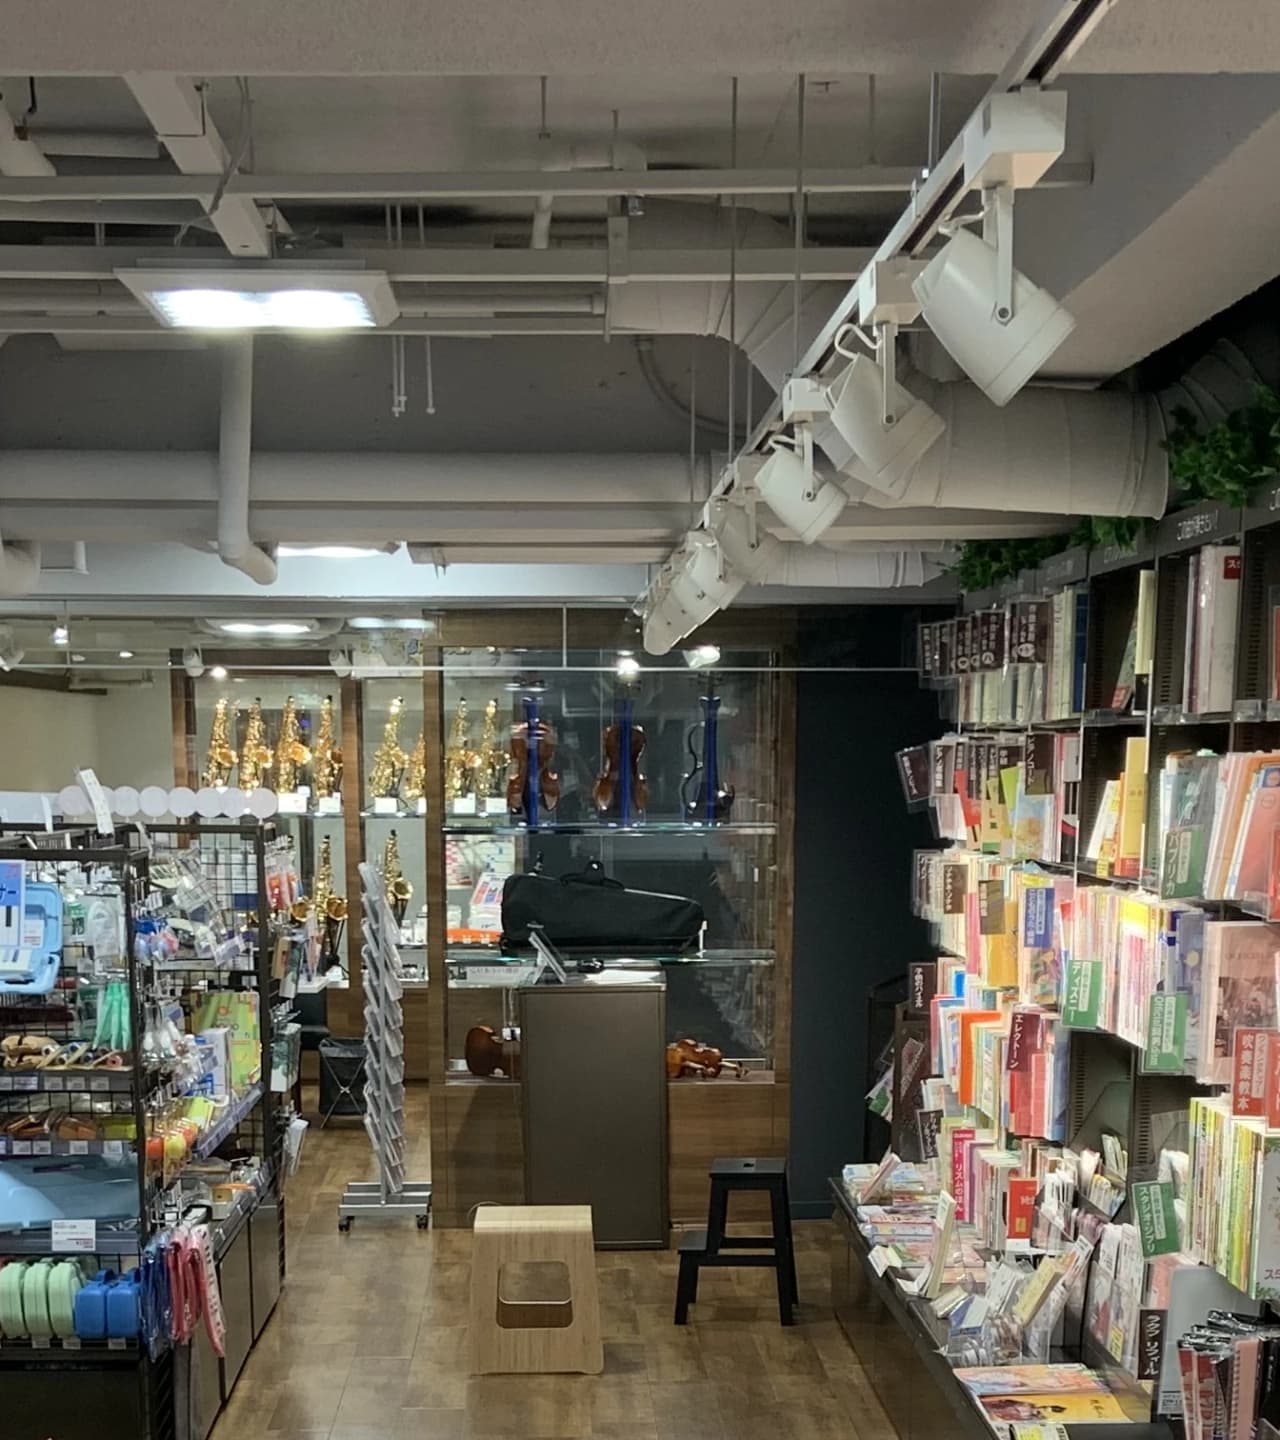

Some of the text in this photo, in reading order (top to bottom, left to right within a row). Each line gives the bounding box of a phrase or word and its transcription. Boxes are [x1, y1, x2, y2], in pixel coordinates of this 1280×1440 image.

[1069, 961, 1081, 1023] ディズニー
[1009, 1014, 1024, 1069] エレクトーン
